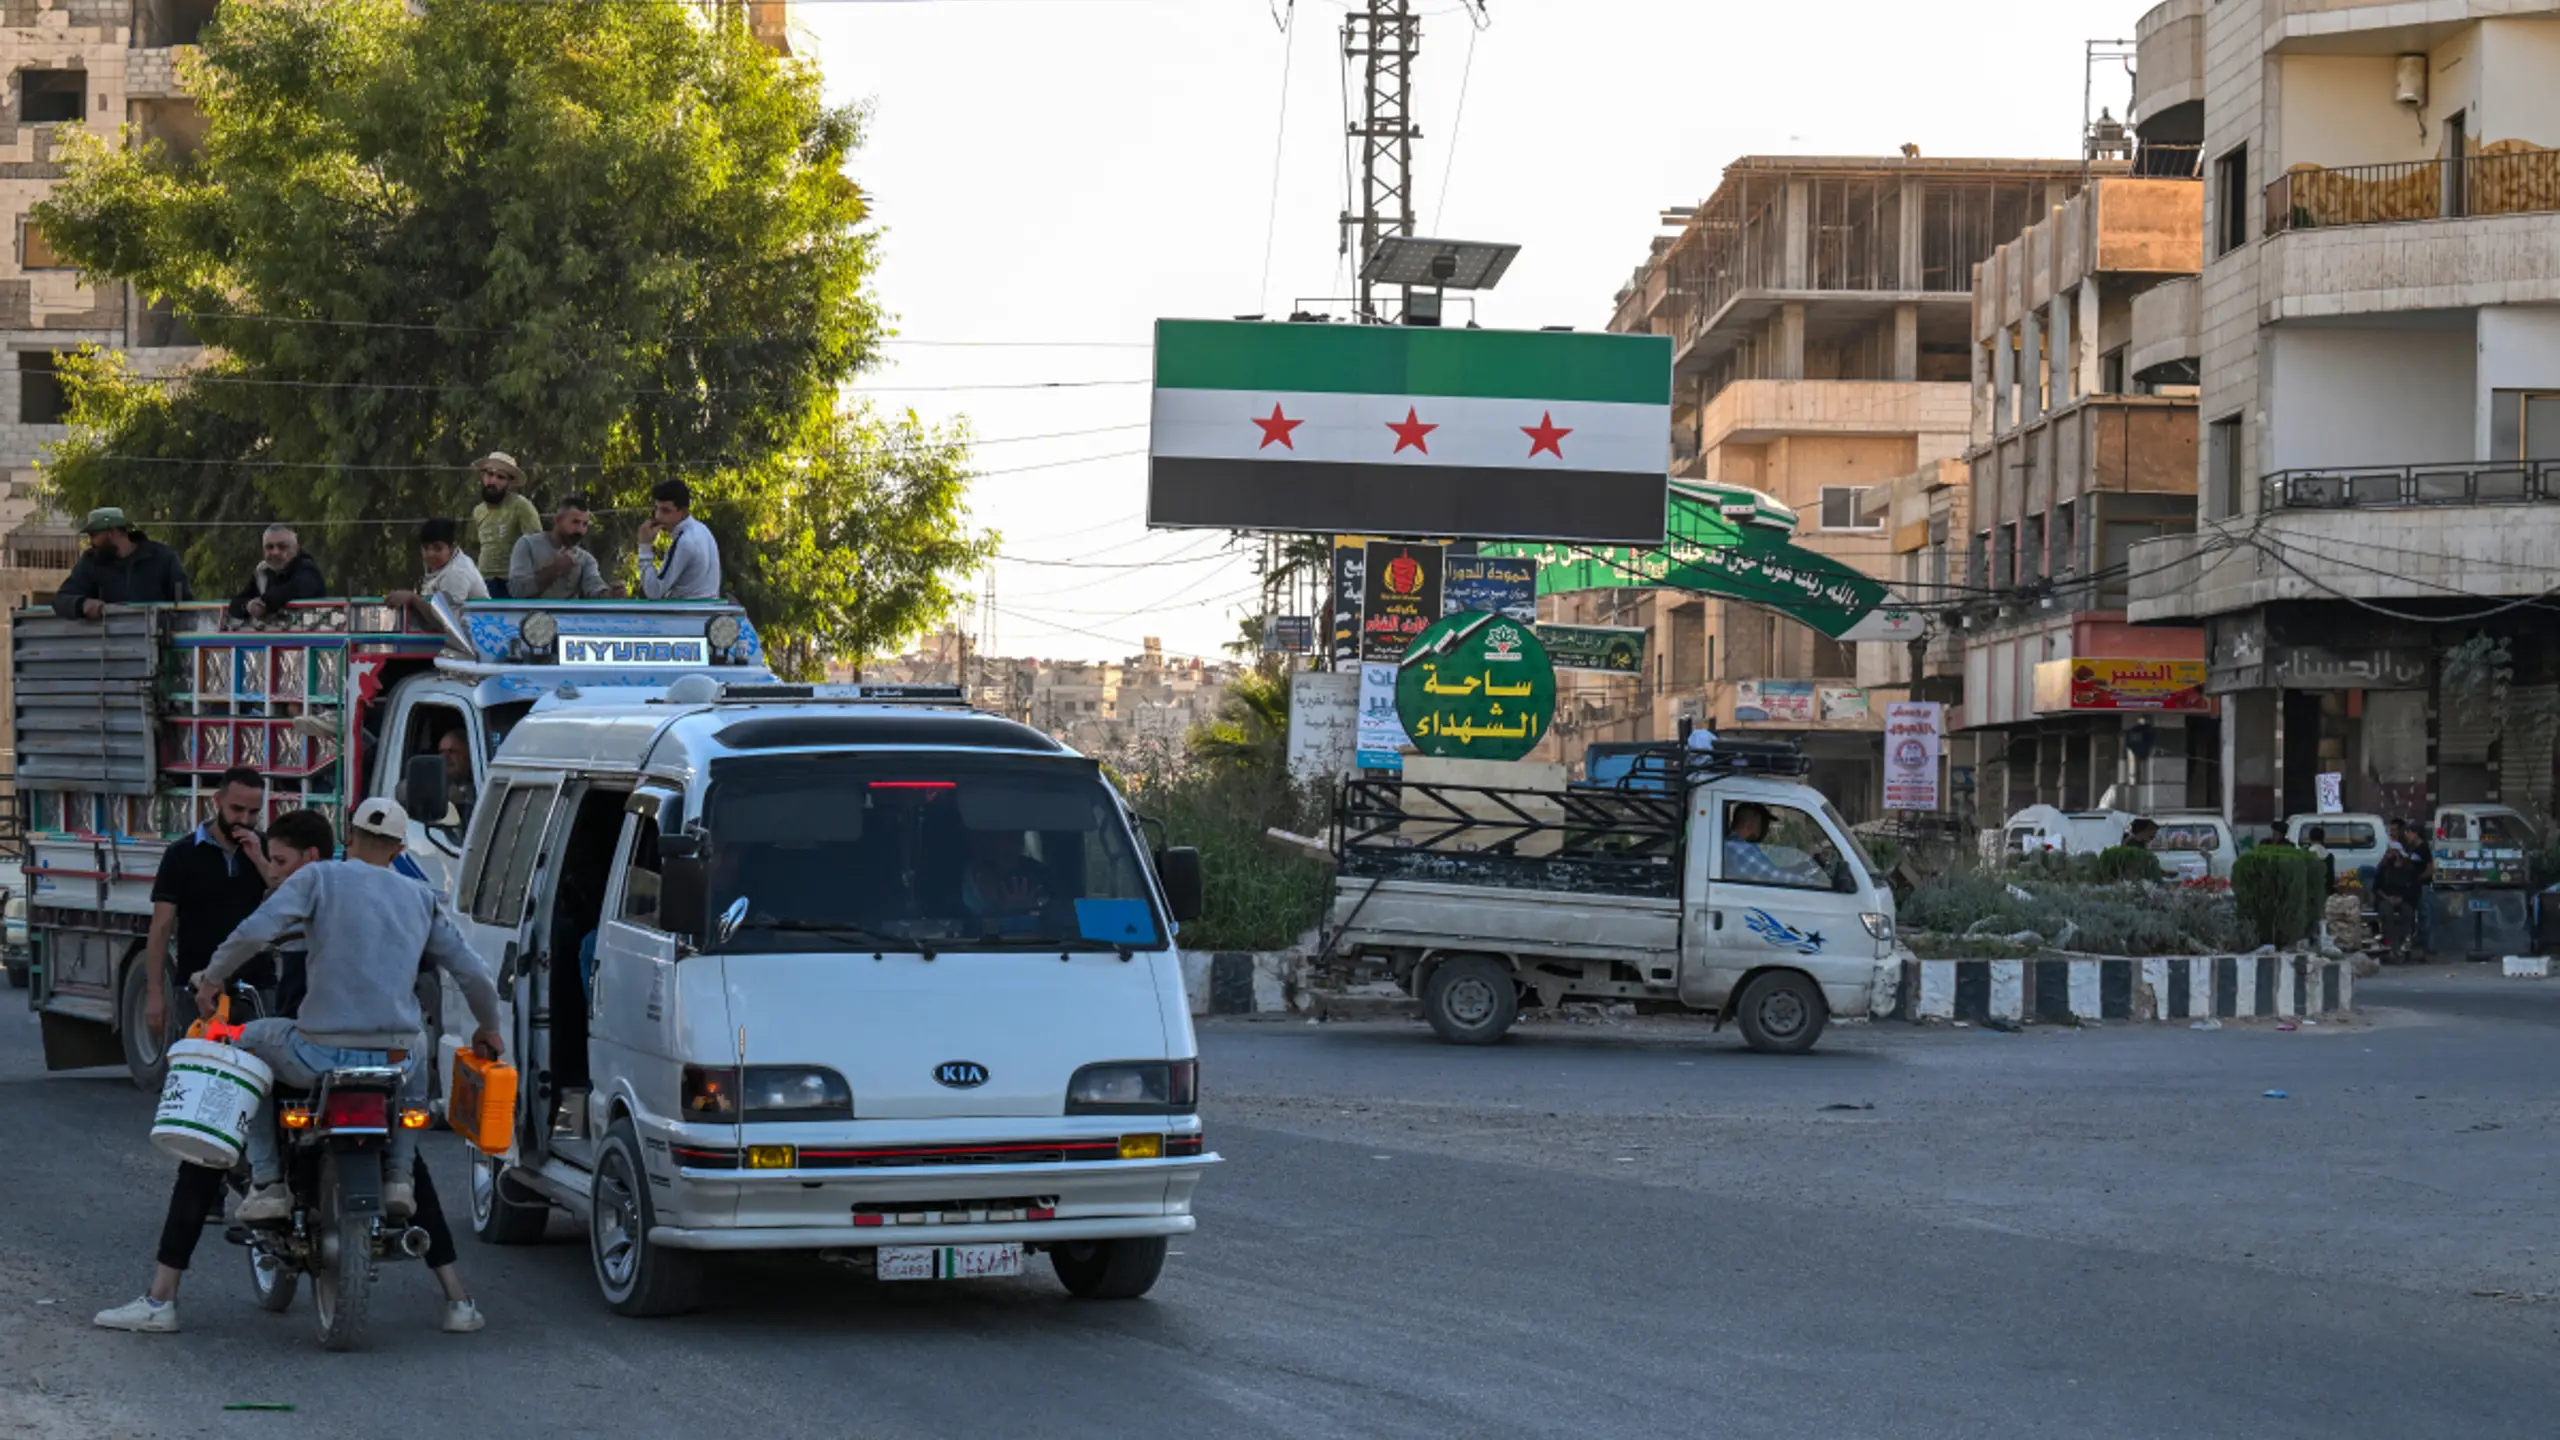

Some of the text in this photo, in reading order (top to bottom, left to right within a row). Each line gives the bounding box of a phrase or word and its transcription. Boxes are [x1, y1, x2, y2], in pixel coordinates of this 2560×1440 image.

[565, 641, 701, 662] HYUNDAI
[1423, 663, 1533, 697] ساحة
[2111, 662, 2173, 686] البشير
[1414, 702, 1538, 745] الشهداء
[942, 1066, 983, 1084] KIA
